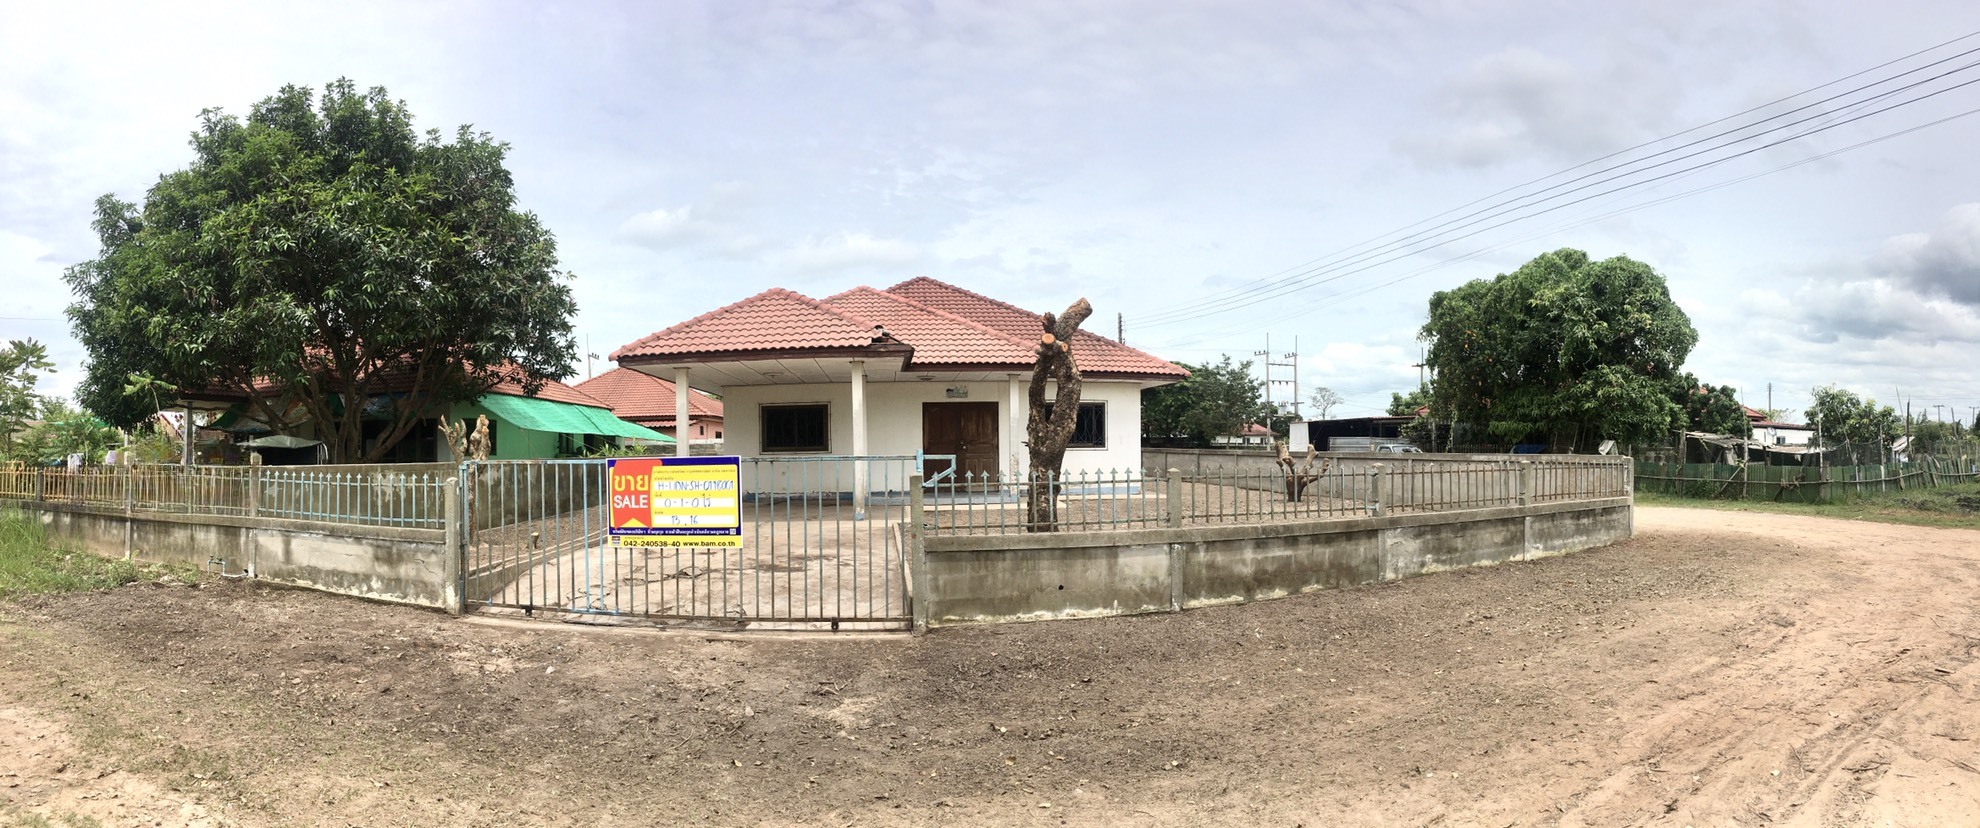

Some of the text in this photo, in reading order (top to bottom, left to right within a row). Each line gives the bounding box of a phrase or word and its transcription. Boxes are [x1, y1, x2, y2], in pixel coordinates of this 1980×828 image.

[614, 475, 649, 492] ขาย
[613, 494, 649, 509] SALE
[623, 540, 681, 548] 042-240538-40
[682, 540, 736, 548] www.bam.co.th
